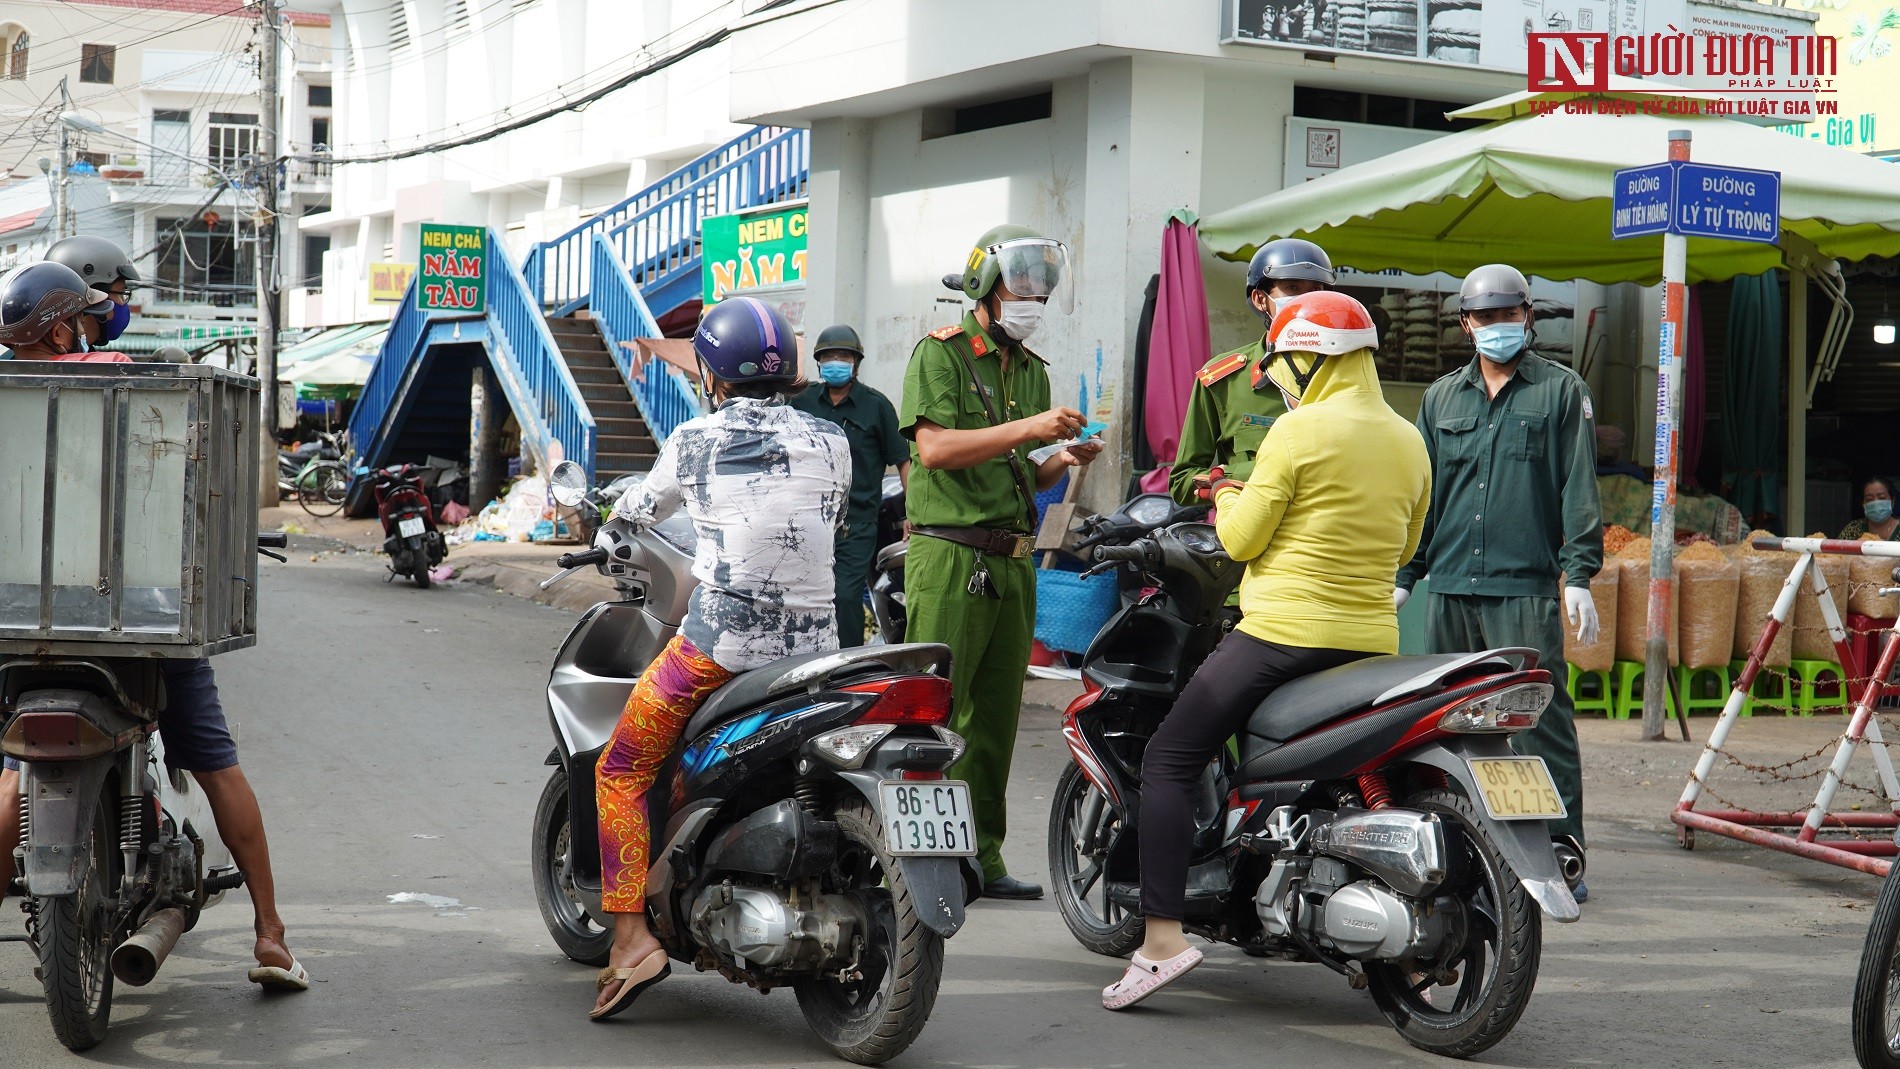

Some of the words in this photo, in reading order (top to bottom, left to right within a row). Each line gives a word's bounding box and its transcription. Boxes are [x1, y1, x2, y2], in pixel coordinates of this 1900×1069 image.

[1826, 116, 1853, 147] Gia
[1628, 175, 1660, 195] ĐƯỜNG
[1702, 176, 1756, 197] ĐƯỜNG
[1632, 201, 1646, 226] TIÊN
[1646, 199, 1668, 223] HOÀNG
[1682, 200, 1700, 225] LÝ
[1704, 203, 1724, 231] TỰ
[1726, 209, 1772, 235] TRỌNG
[423, 231, 452, 248] NEM
[454, 228, 482, 249] CHẢ
[738, 217, 784, 245] NEM
[424, 248, 481, 279] NĂM
[711, 245, 785, 301] NĂM
[424, 279, 479, 308] TÀU
[1481, 760, 1541, 787] 86-B1
[896, 785, 958, 818] 86-C1
[1485, 787, 1560, 816] 042.75
[892, 819, 971, 851] 139.61
[1341, 917, 1379, 931] SUZUKI
